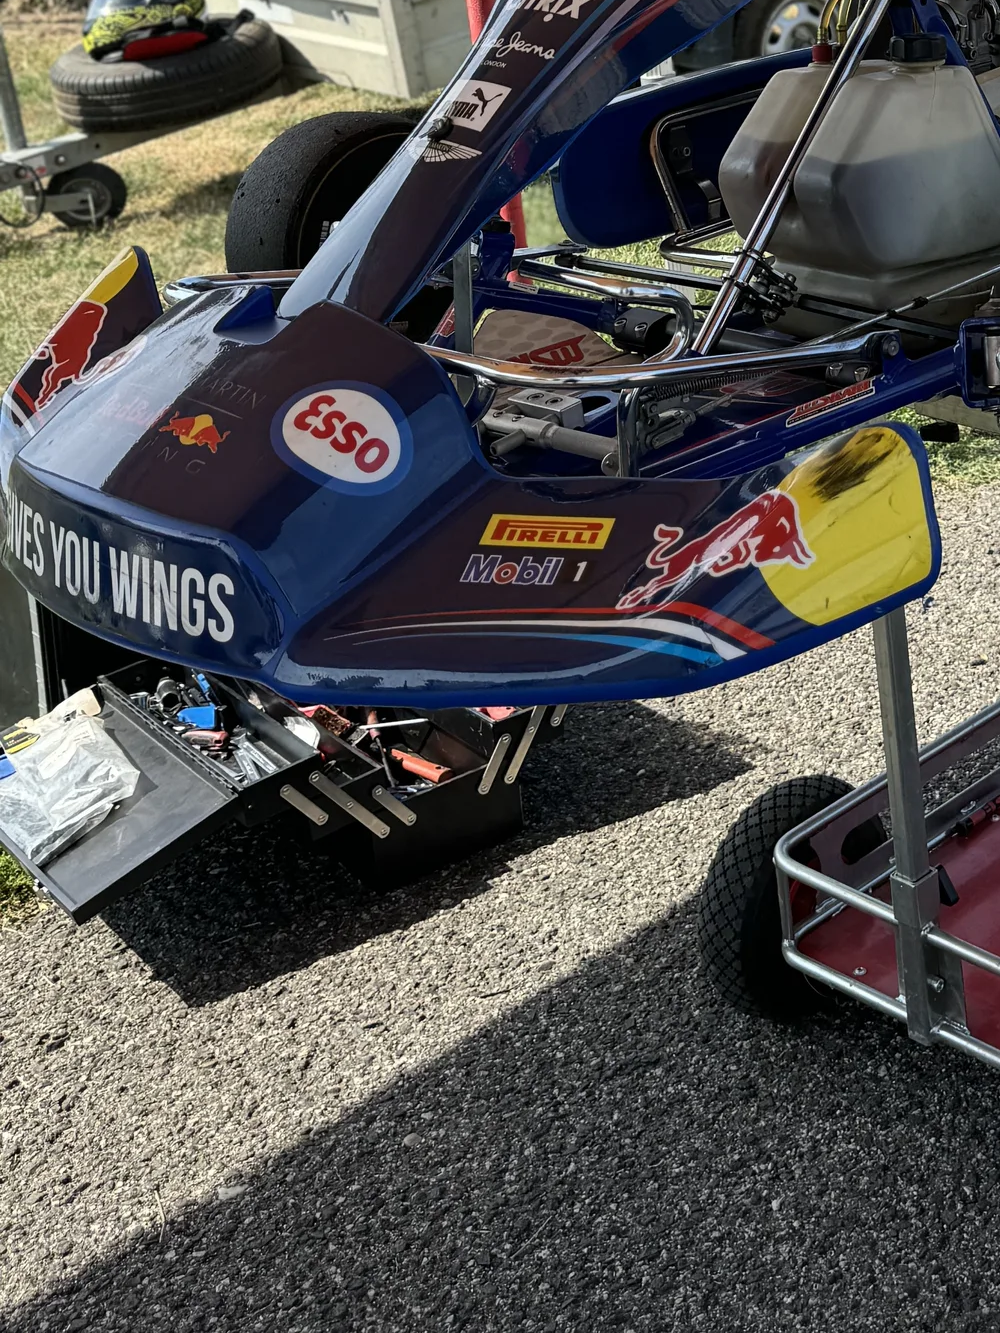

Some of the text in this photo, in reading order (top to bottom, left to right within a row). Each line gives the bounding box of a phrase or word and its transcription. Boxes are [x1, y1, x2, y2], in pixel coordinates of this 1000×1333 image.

[496, 31, 555, 60] Jeans
[198, 375, 268, 410] ARTIN
[490, 519, 604, 544] PIRELLI
[50, 520, 100, 605] YOU
[109, 546, 235, 643] WINGS
[459, 553, 588, 585] Mobil 1
